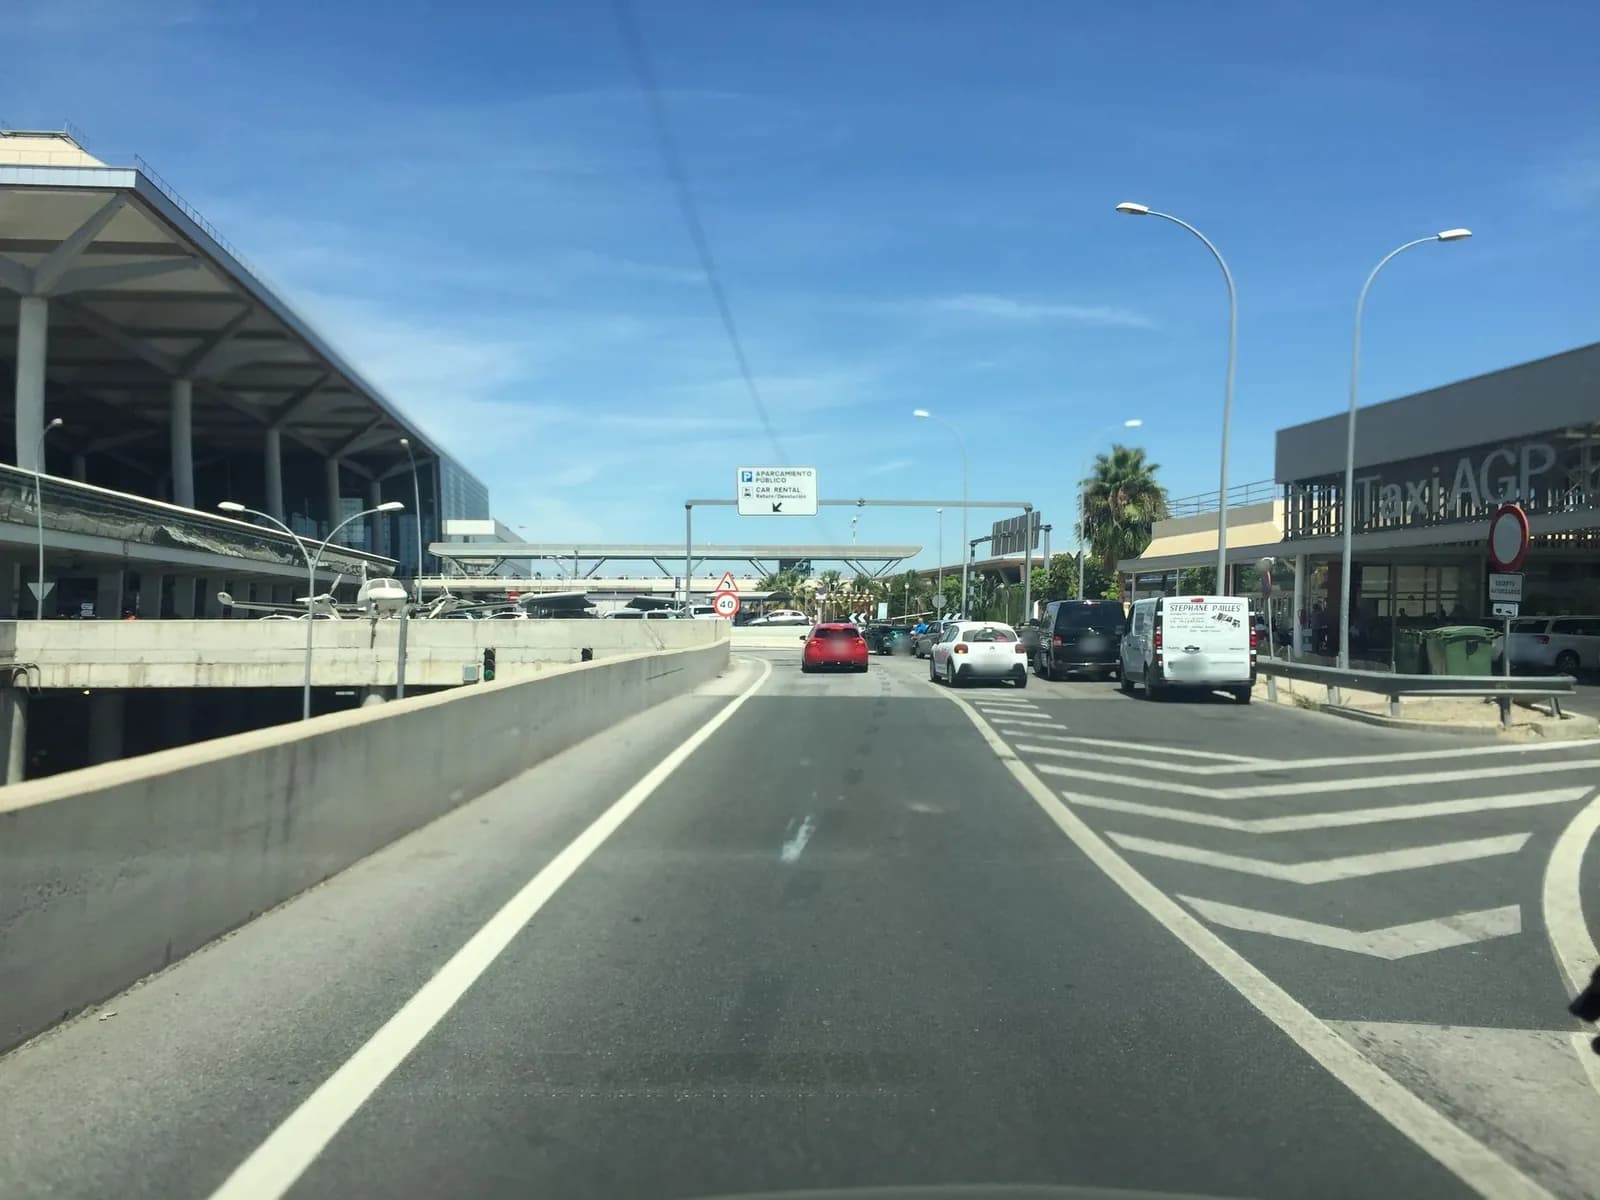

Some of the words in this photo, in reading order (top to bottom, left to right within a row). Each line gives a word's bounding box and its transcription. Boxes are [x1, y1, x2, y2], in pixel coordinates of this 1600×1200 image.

[1355, 465, 1441, 524] Taxi
[1449, 443, 1557, 511] AGP
[719, 600, 734, 608] 40
[1169, 604, 1209, 612] STEPHANE
[1212, 604, 1241, 612] PAILLES
